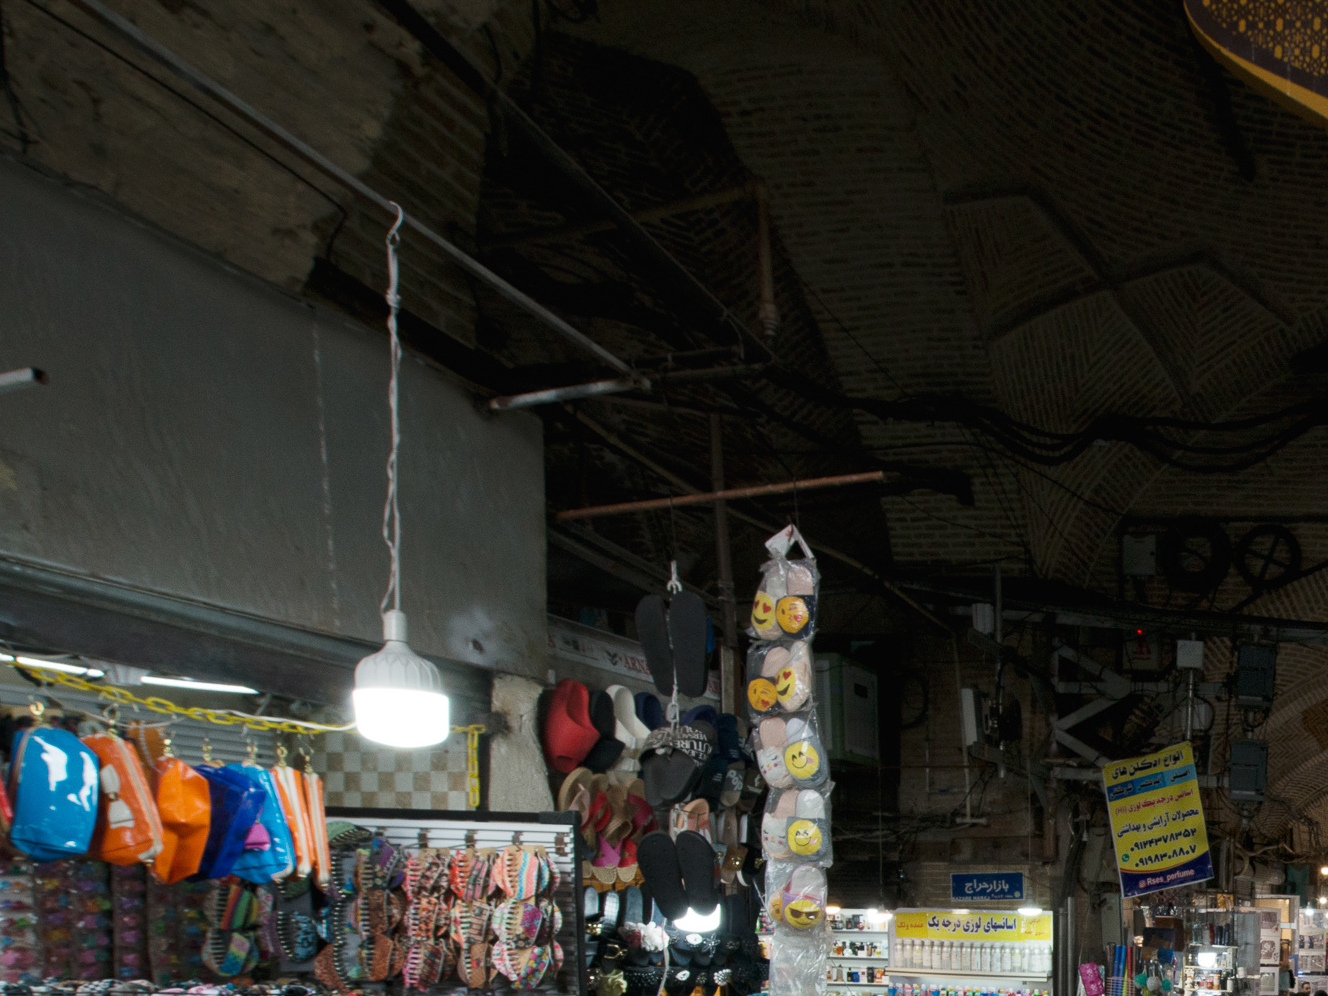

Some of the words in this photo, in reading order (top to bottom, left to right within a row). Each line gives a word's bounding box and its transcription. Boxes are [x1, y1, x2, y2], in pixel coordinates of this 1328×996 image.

[1163, 749, 1184, 767] انواع
[1111, 764, 1128, 780] های
[1129, 757, 1161, 776] ادکلن
[1142, 798, 1156, 809] یک
[1156, 794, 1174, 805] درجه
[1147, 812, 1170, 831] آرایشی
[1117, 823, 1142, 838] بهداشتی
[927, 915, 940, 931] یک
[941, 918, 961, 933] درجه
[962, 915, 982, 933] لوزی
[983, 916, 1017, 933] اسانسهای
